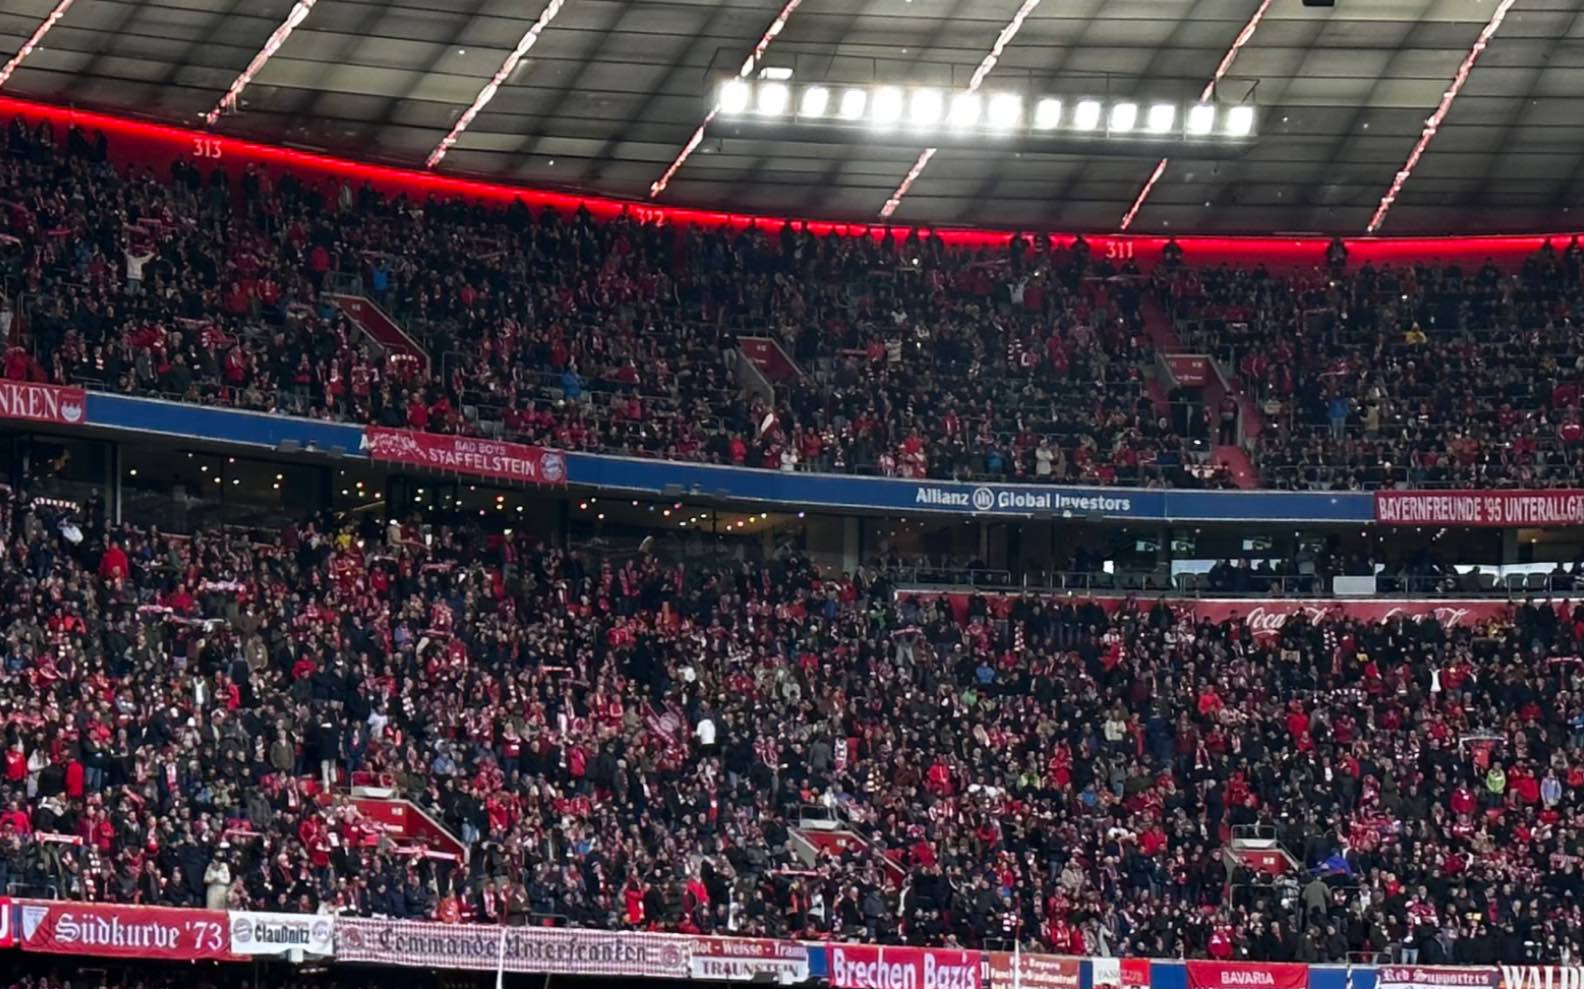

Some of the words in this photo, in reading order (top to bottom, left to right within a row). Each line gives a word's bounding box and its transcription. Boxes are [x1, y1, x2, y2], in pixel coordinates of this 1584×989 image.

[192, 138, 222, 159] 313
[1105, 240, 1134, 260] 311
[454, 440, 476, 453] BAD
[478, 442, 506, 455] BOYS
[428, 447, 536, 477] STAFFELSTEIN
[915, 487, 969, 506] Allianz
[997, 491, 1051, 509] Global
[1054, 493, 1131, 511] Investors
[1378, 496, 1482, 522] BAYERNFREUNDE
[1483, 496, 1503, 522] '95
[54, 912, 179, 949] Südkurve
[185, 921, 223, 950] '73
[1220, 970, 1274, 985] BAVARIA
[1382, 968, 1409, 983] Red
[1412, 968, 1490, 986] Supporters
